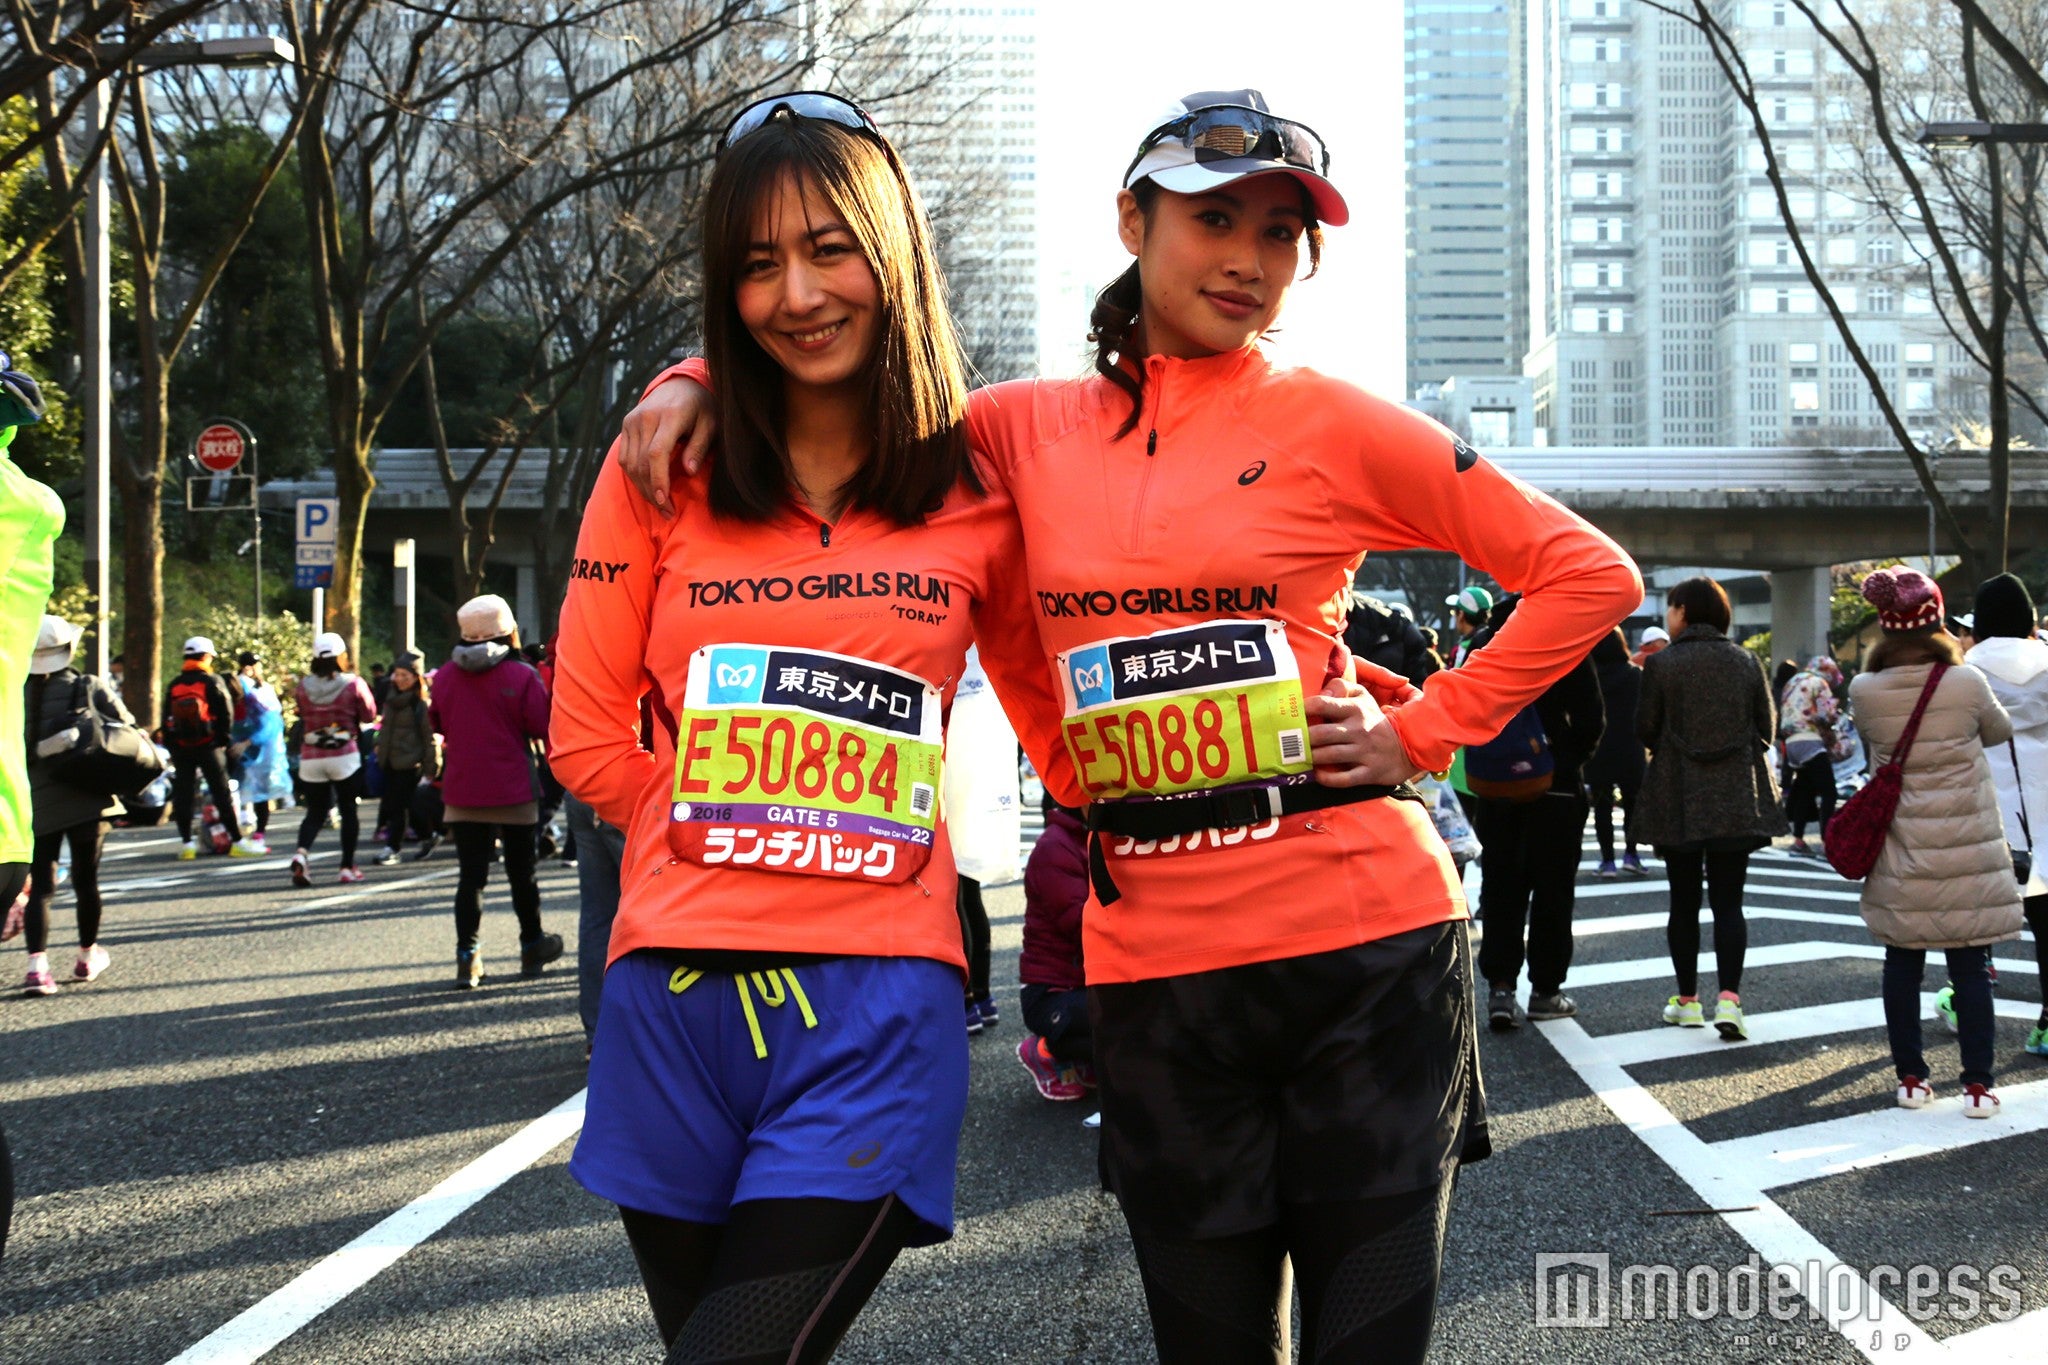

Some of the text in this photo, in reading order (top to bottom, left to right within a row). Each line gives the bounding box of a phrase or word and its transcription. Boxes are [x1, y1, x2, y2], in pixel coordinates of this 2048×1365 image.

[304, 503, 330, 538] P
[571, 558, 630, 583] ORAY'
[687, 571, 950, 609] TOKYO GIRLS RUN
[1036, 583, 1279, 618] TOKYO GIRLS RUN
[1121, 639, 1262, 683] 東京メトロ
[775, 665, 912, 720] 東京メトロ
[1066, 693, 1259, 794] E50881
[679, 715, 899, 814] E50884
[693, 805, 733, 821] 2016
[766, 805, 838, 828] GATE 5
[702, 827, 896, 878] ランチパック
[910, 827, 930, 845] 22
